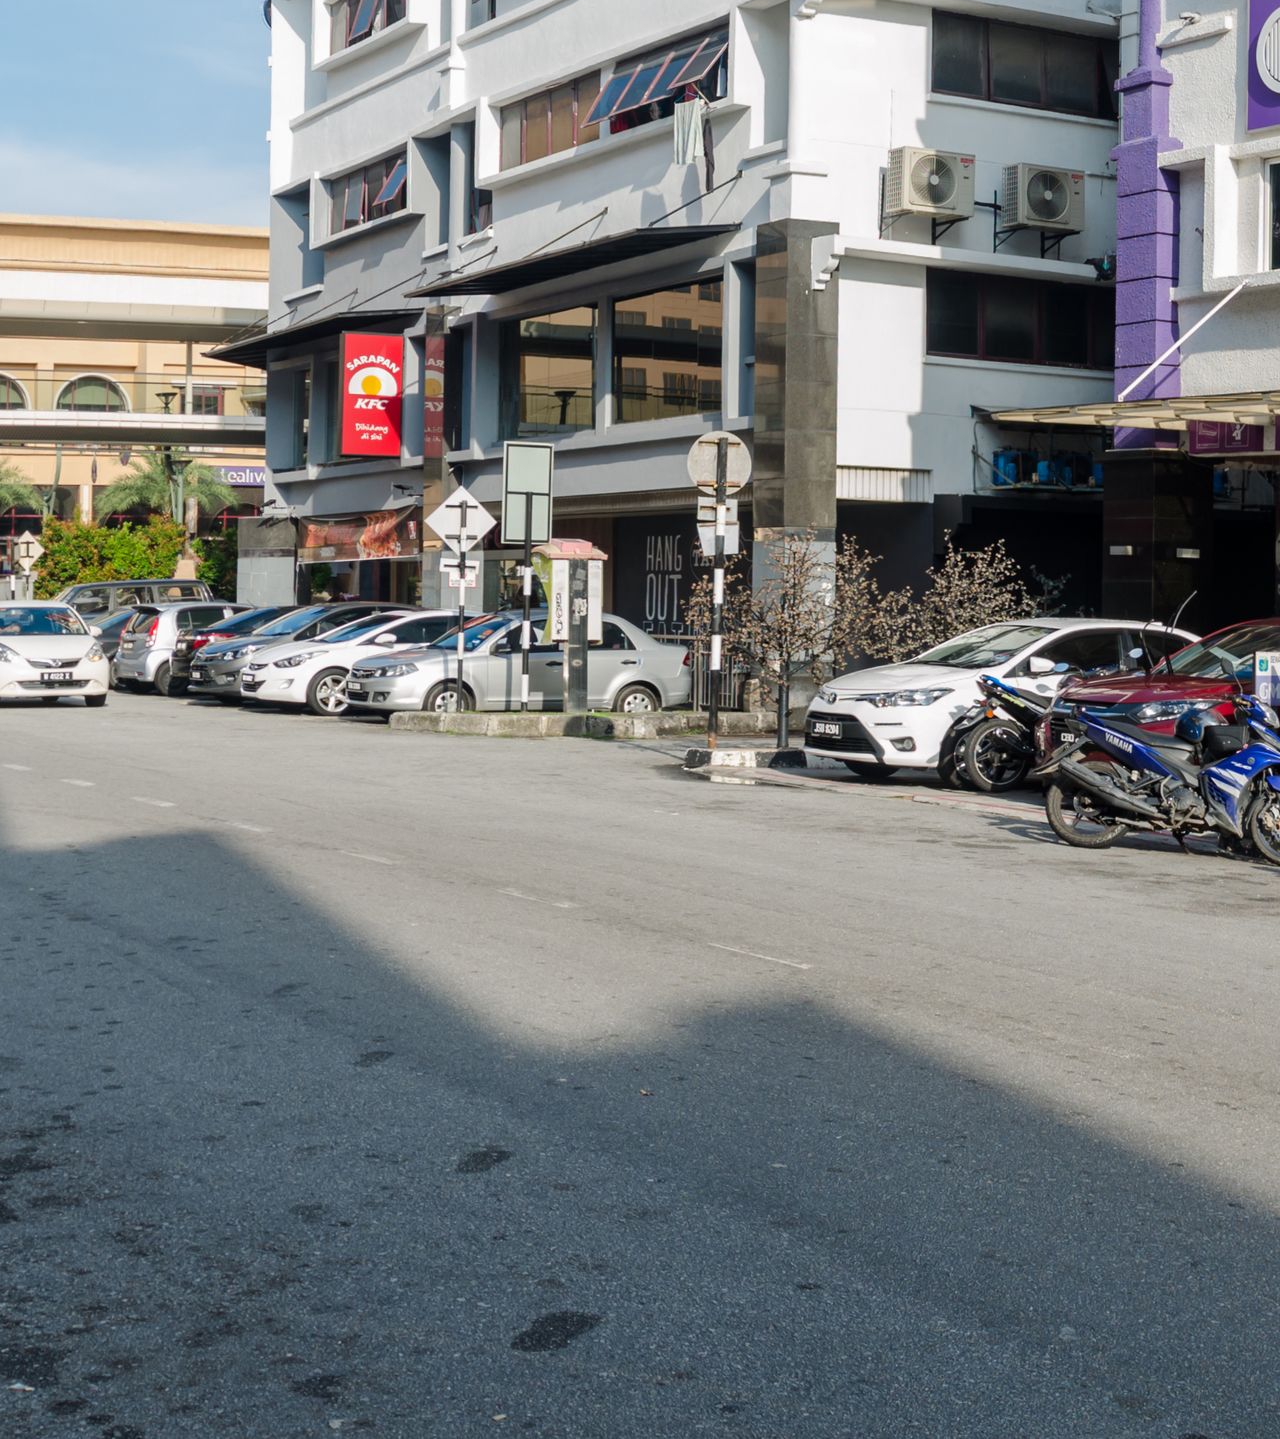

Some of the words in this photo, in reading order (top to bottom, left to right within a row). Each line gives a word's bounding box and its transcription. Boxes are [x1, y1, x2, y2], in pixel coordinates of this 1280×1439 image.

[346, 355, 400, 374] SARAPAN
[354, 398, 390, 411] KFC
[646, 534, 683, 572] HANG
[645, 573, 683, 622] OUT
[1104, 732, 1133, 754] YAMAHA
